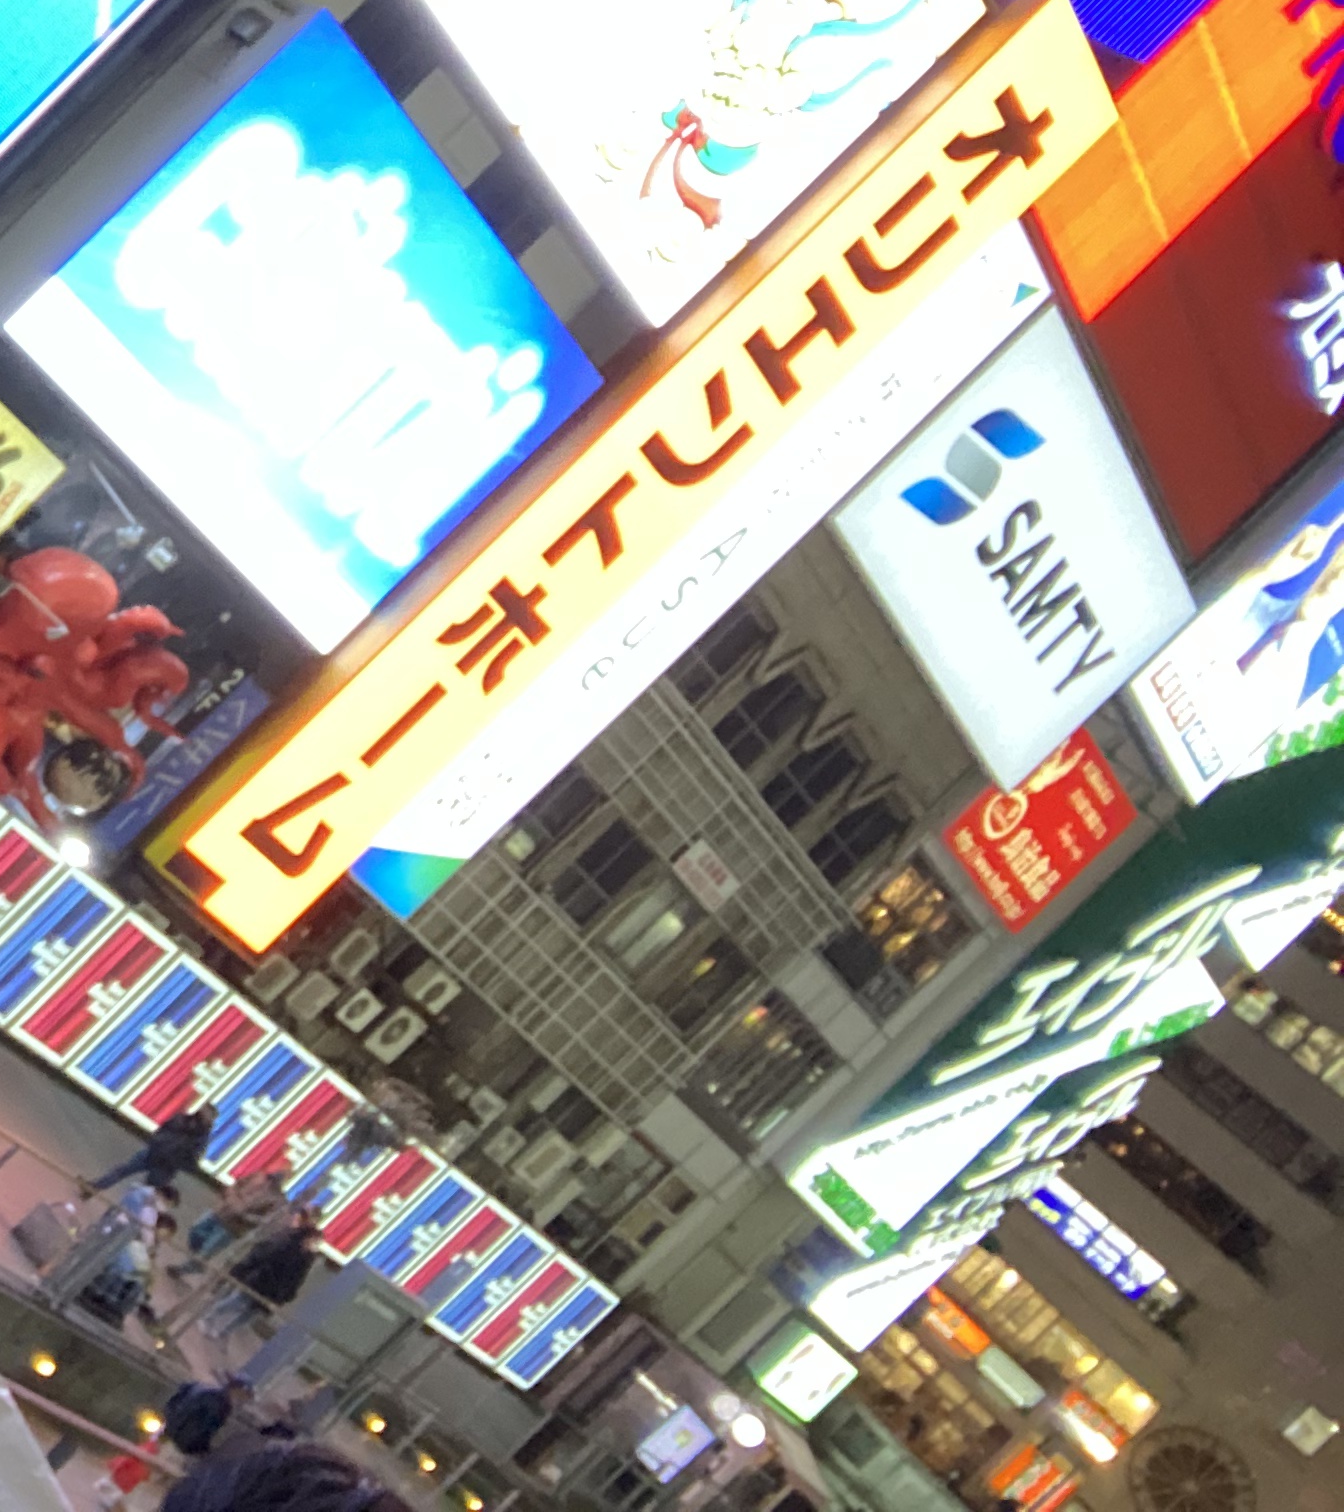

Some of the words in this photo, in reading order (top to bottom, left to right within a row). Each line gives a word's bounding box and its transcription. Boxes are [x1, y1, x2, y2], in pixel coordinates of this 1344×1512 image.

[241, 85, 1055, 878] オリエントホーム
[976, 499, 1116, 695] SAMTY
[978, 896, 1238, 1046] エイブル
